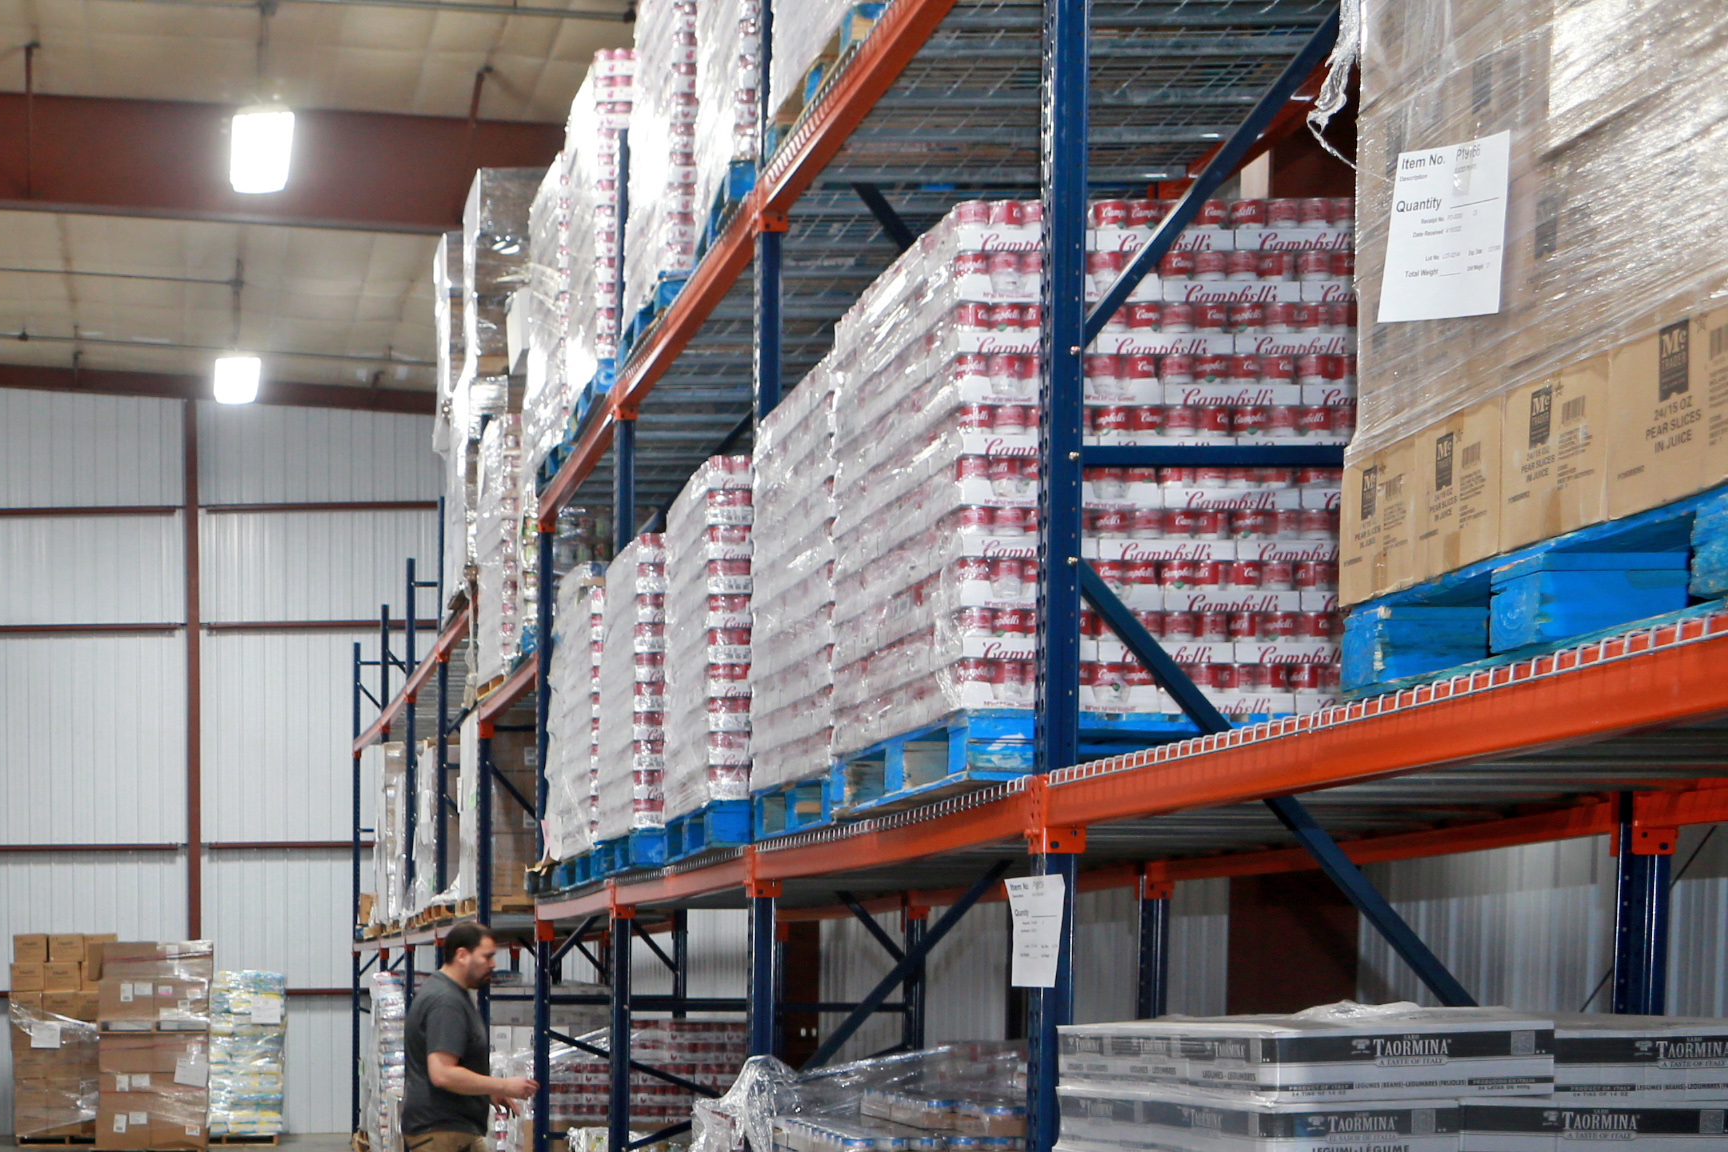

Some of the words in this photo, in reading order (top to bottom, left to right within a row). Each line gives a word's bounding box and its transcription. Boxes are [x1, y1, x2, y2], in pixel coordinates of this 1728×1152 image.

[1402, 158, 1425, 170] Item
[1429, 154, 1445, 165] No.
[1396, 198, 1442, 213] Quantity
[1646, 423, 1668, 440] PEAR
[1671, 409, 1701, 429] SLICES
[1655, 440, 1664, 453] IN
[1666, 429, 1692, 450] JUICE
[1373, 1038, 1448, 1057] TAORMINA
[1328, 1116, 1395, 1133] TAORMINA
[1562, 1111, 1638, 1130] TAORMINA
